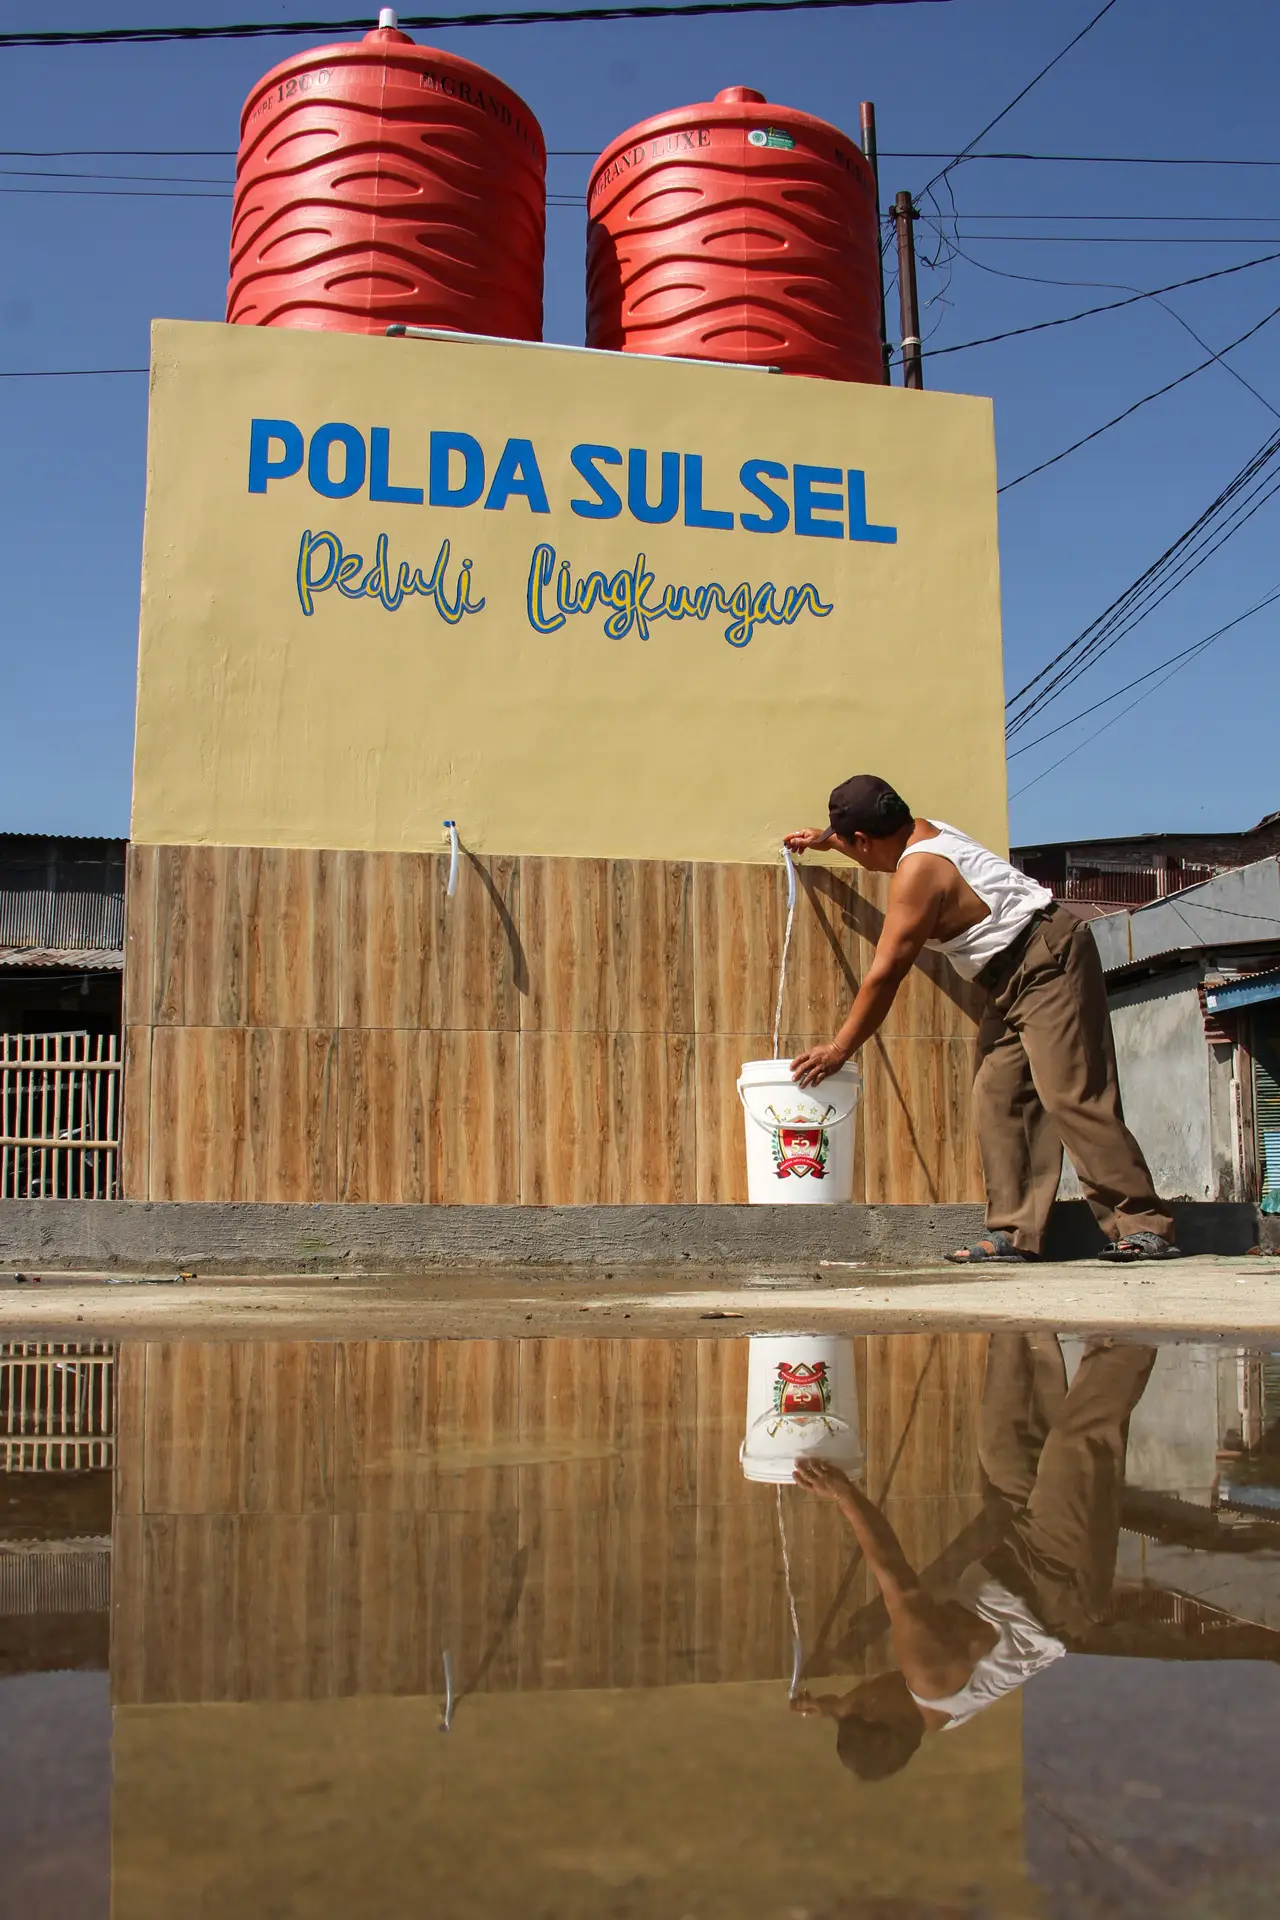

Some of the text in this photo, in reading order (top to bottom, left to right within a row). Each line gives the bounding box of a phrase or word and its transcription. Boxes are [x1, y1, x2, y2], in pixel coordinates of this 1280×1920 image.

[277, 69, 331, 104] 1200
[441, 75, 512, 127] GRAND
[652, 128, 711, 159] LUXE
[249, 418, 897, 544] POLDA SULSEL
[296, 529, 485, 624] Peduli
[791, 1139, 810, 1153] 52
